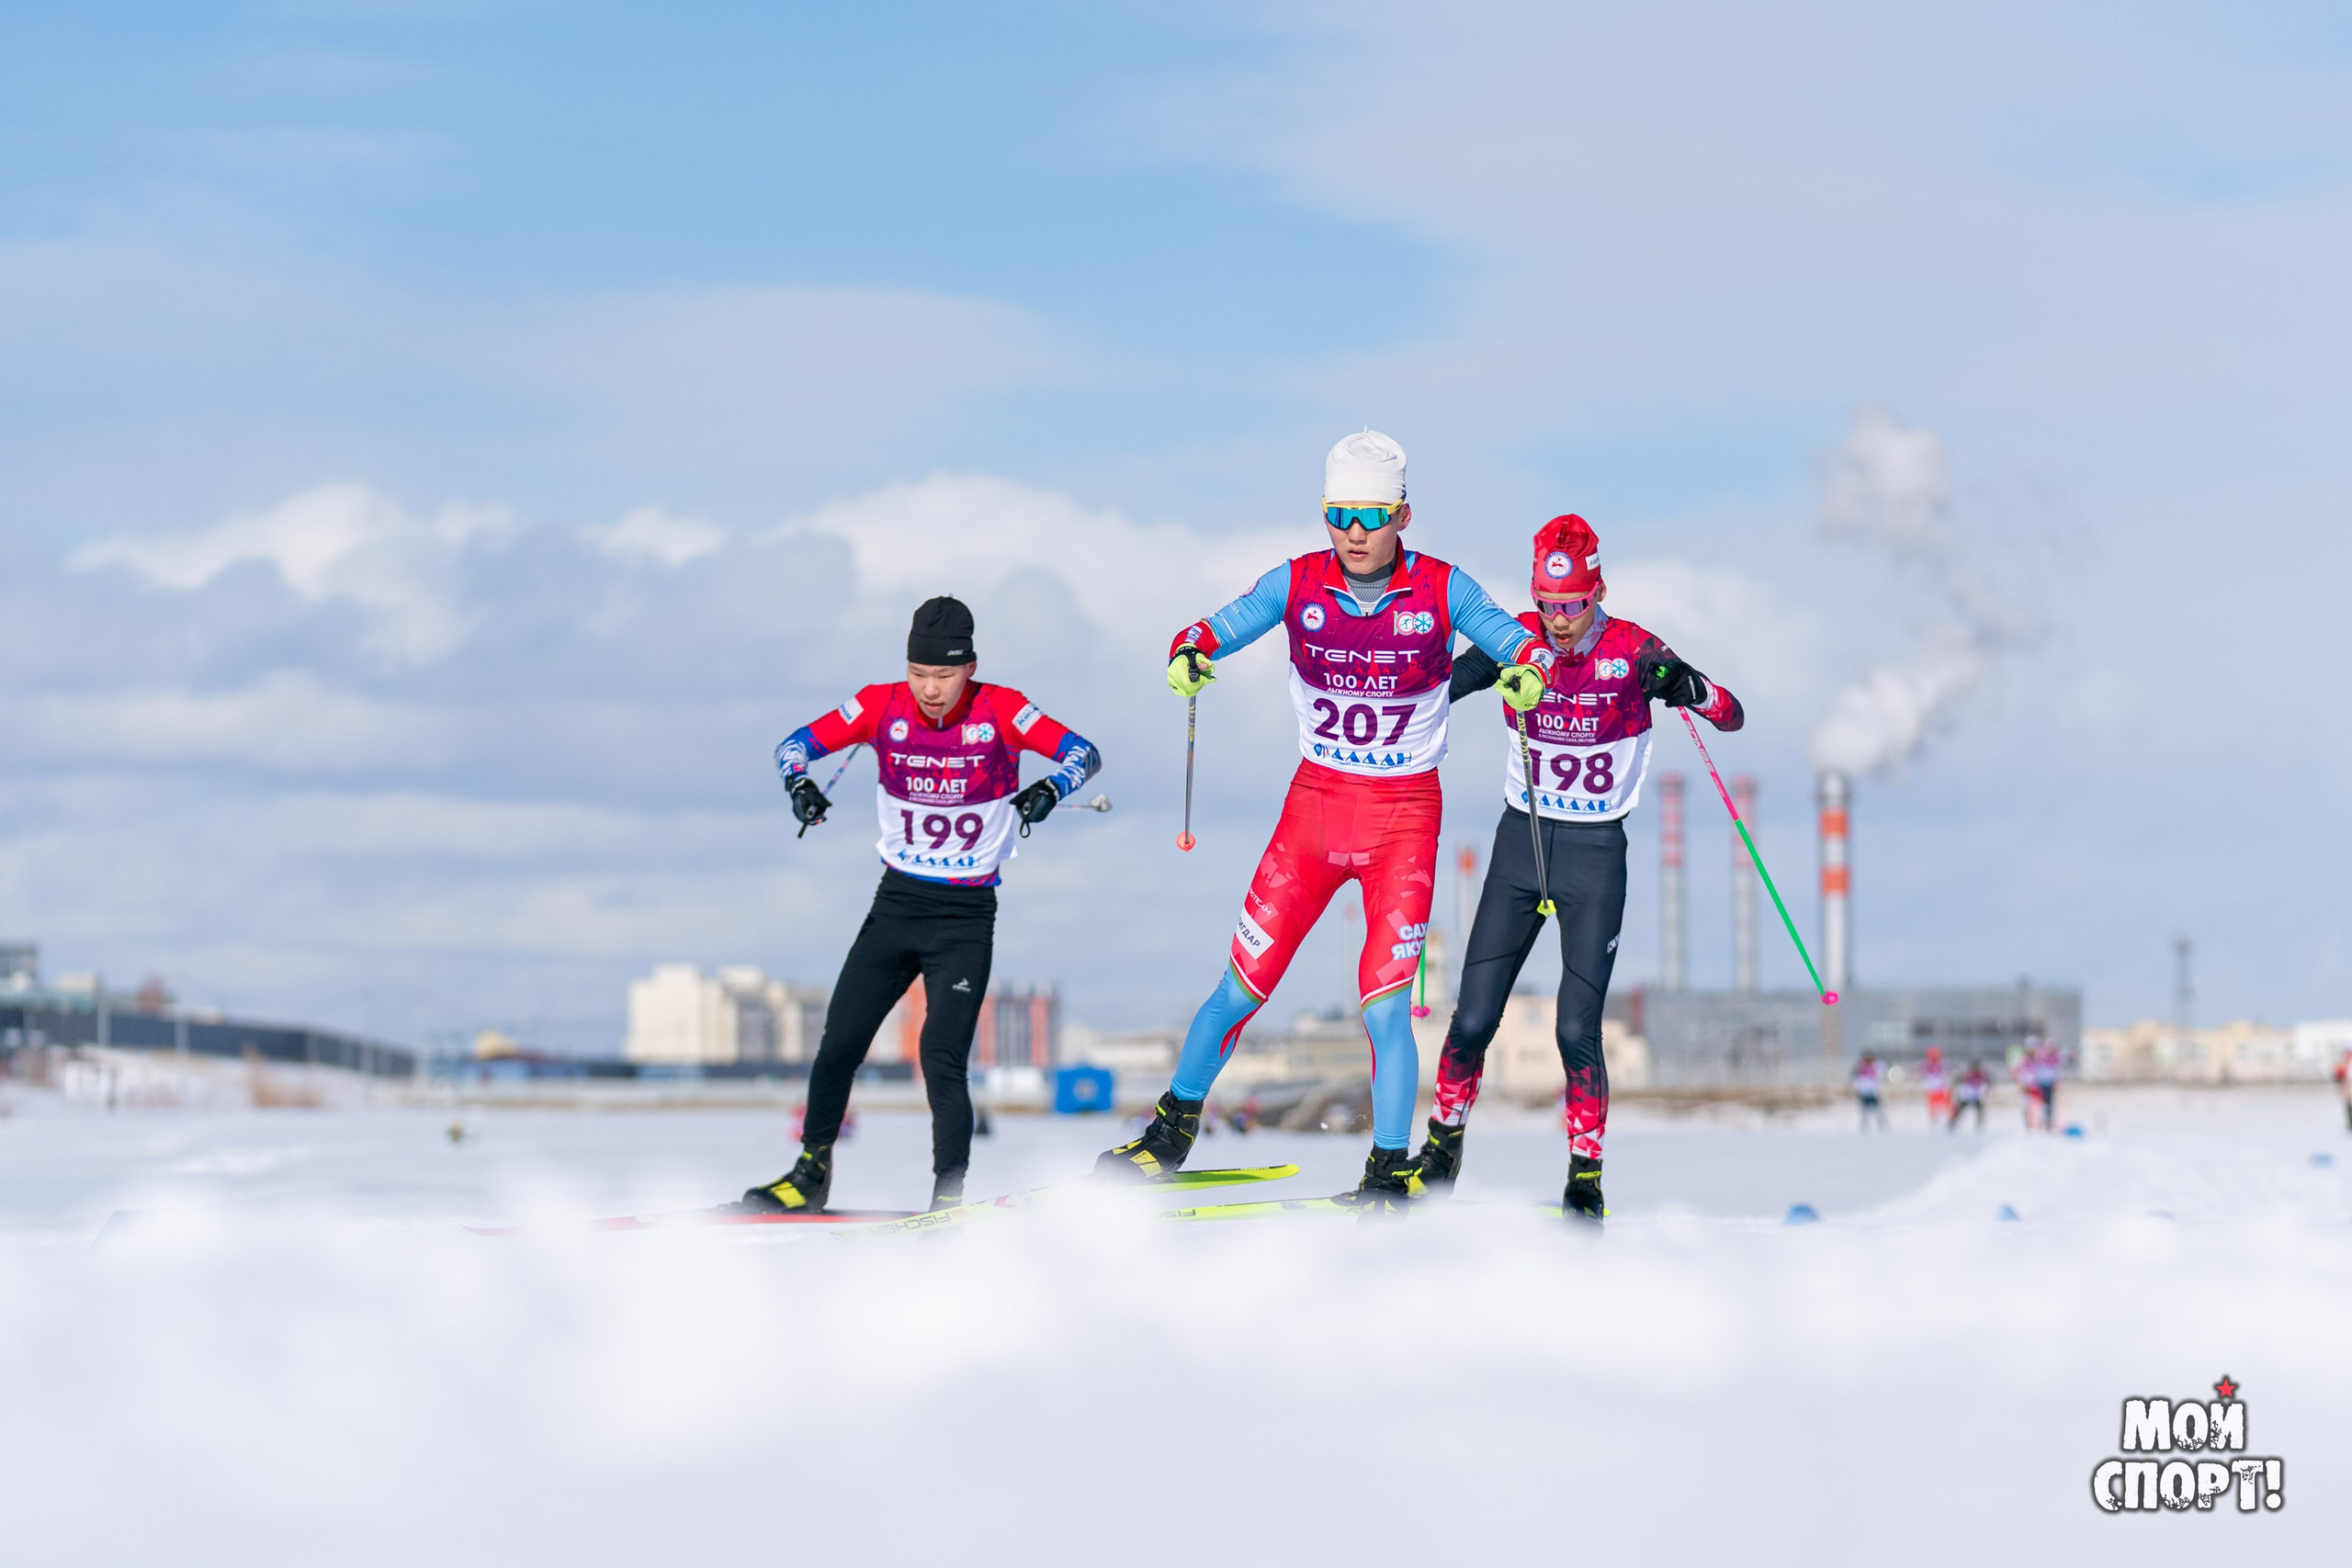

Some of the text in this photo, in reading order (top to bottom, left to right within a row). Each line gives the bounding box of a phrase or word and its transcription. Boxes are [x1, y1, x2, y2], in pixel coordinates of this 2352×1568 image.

[1305, 642, 1420, 664] TENET
[1323, 672, 1398, 690] 100 ЛЕТ
[1541, 692, 1618, 705] ENET
[1312, 697, 1418, 746] 207
[1535, 713, 1600, 732] 100 ЛЕТ
[890, 752, 985, 768] TENET
[1530, 750, 1614, 794] 198
[905, 776, 967, 793] 100 ЛЕТ
[900, 808, 984, 851] 199
